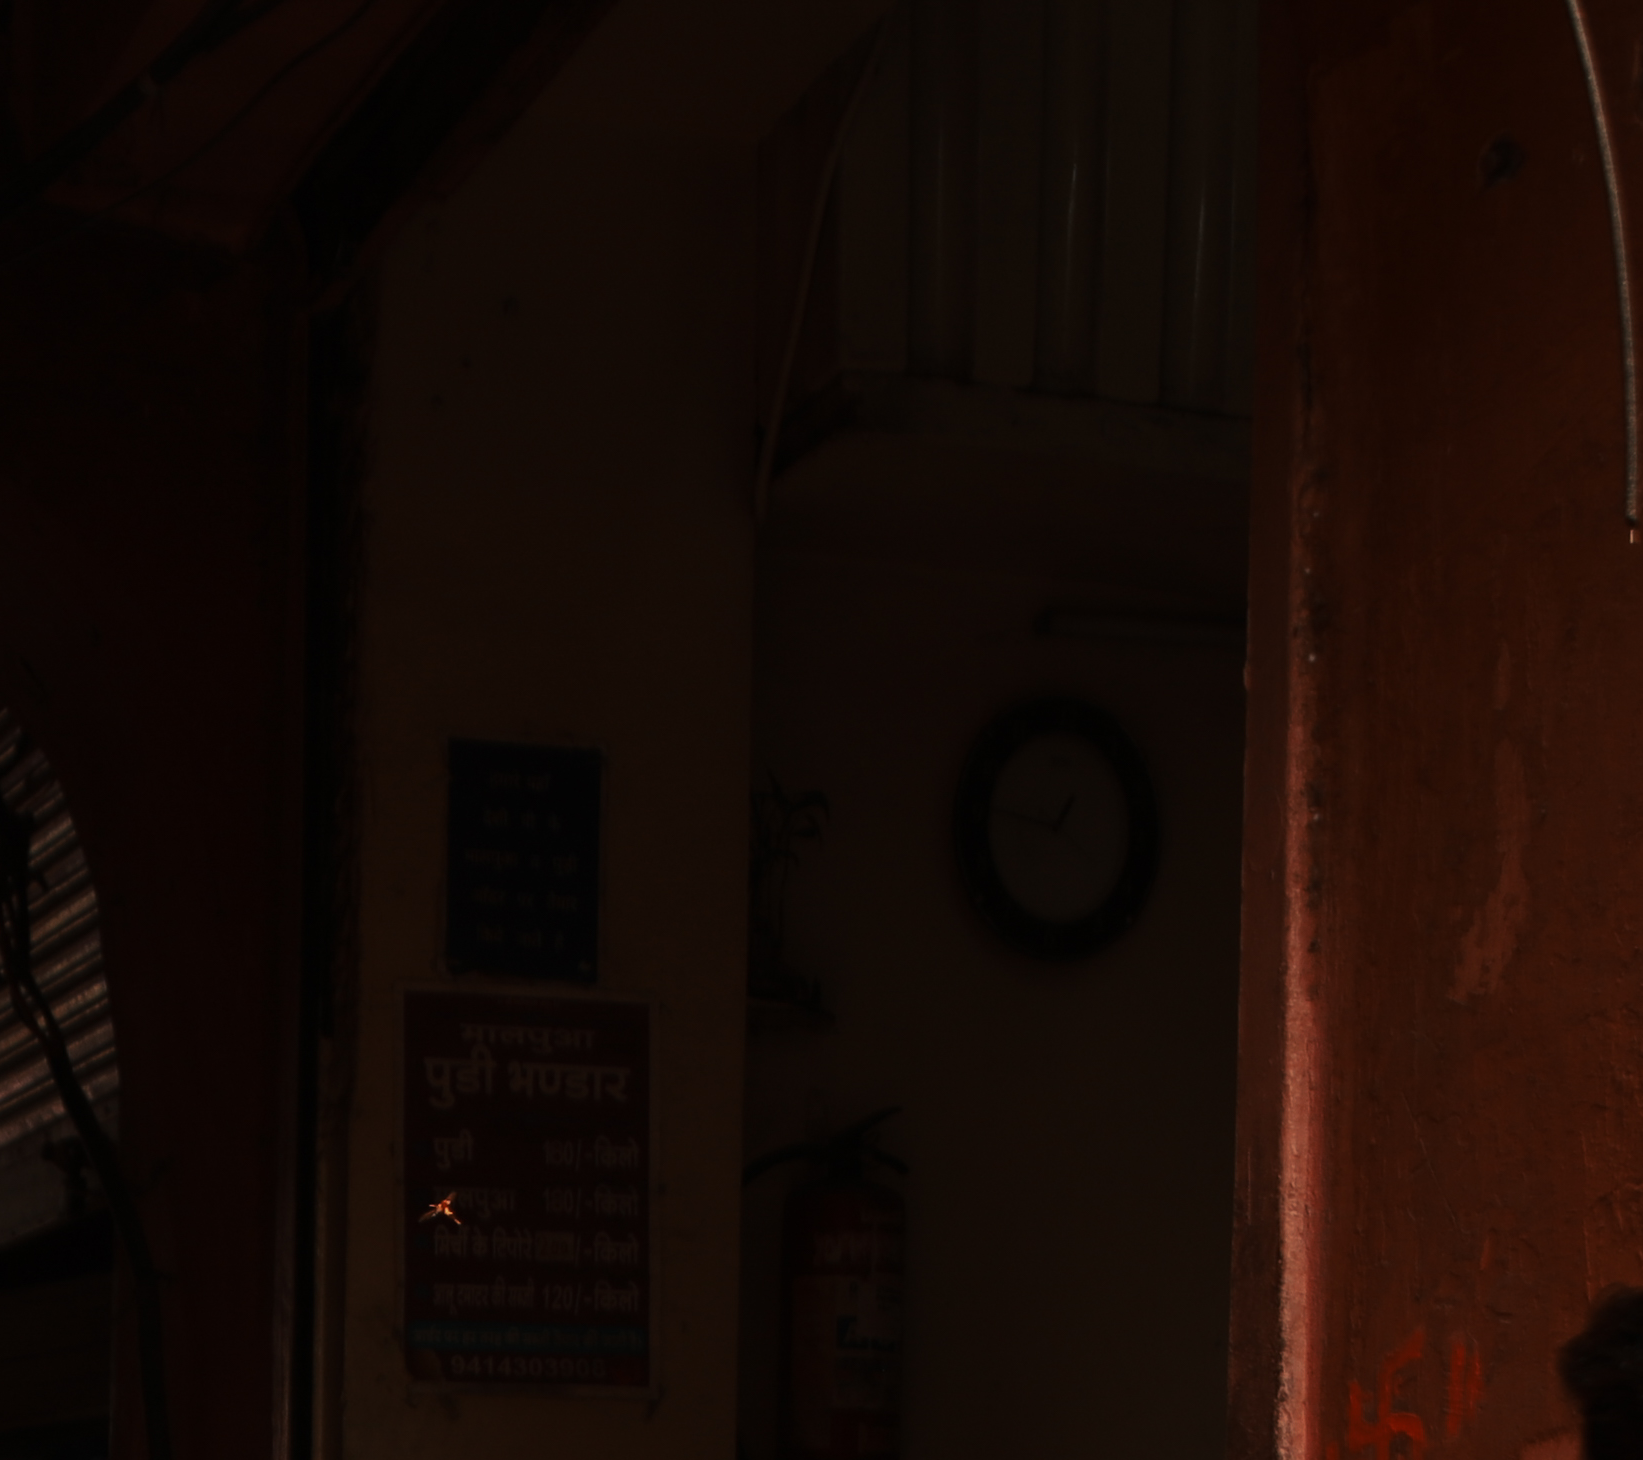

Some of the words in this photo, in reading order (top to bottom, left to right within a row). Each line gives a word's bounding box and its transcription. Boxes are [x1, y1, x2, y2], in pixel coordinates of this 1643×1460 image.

[460, 1022, 595, 1054] मालपुआ
[423, 1043, 497, 1109] पुडी
[507, 1058, 631, 1104] भण्डार
[433, 1128, 475, 1172] पुडी
